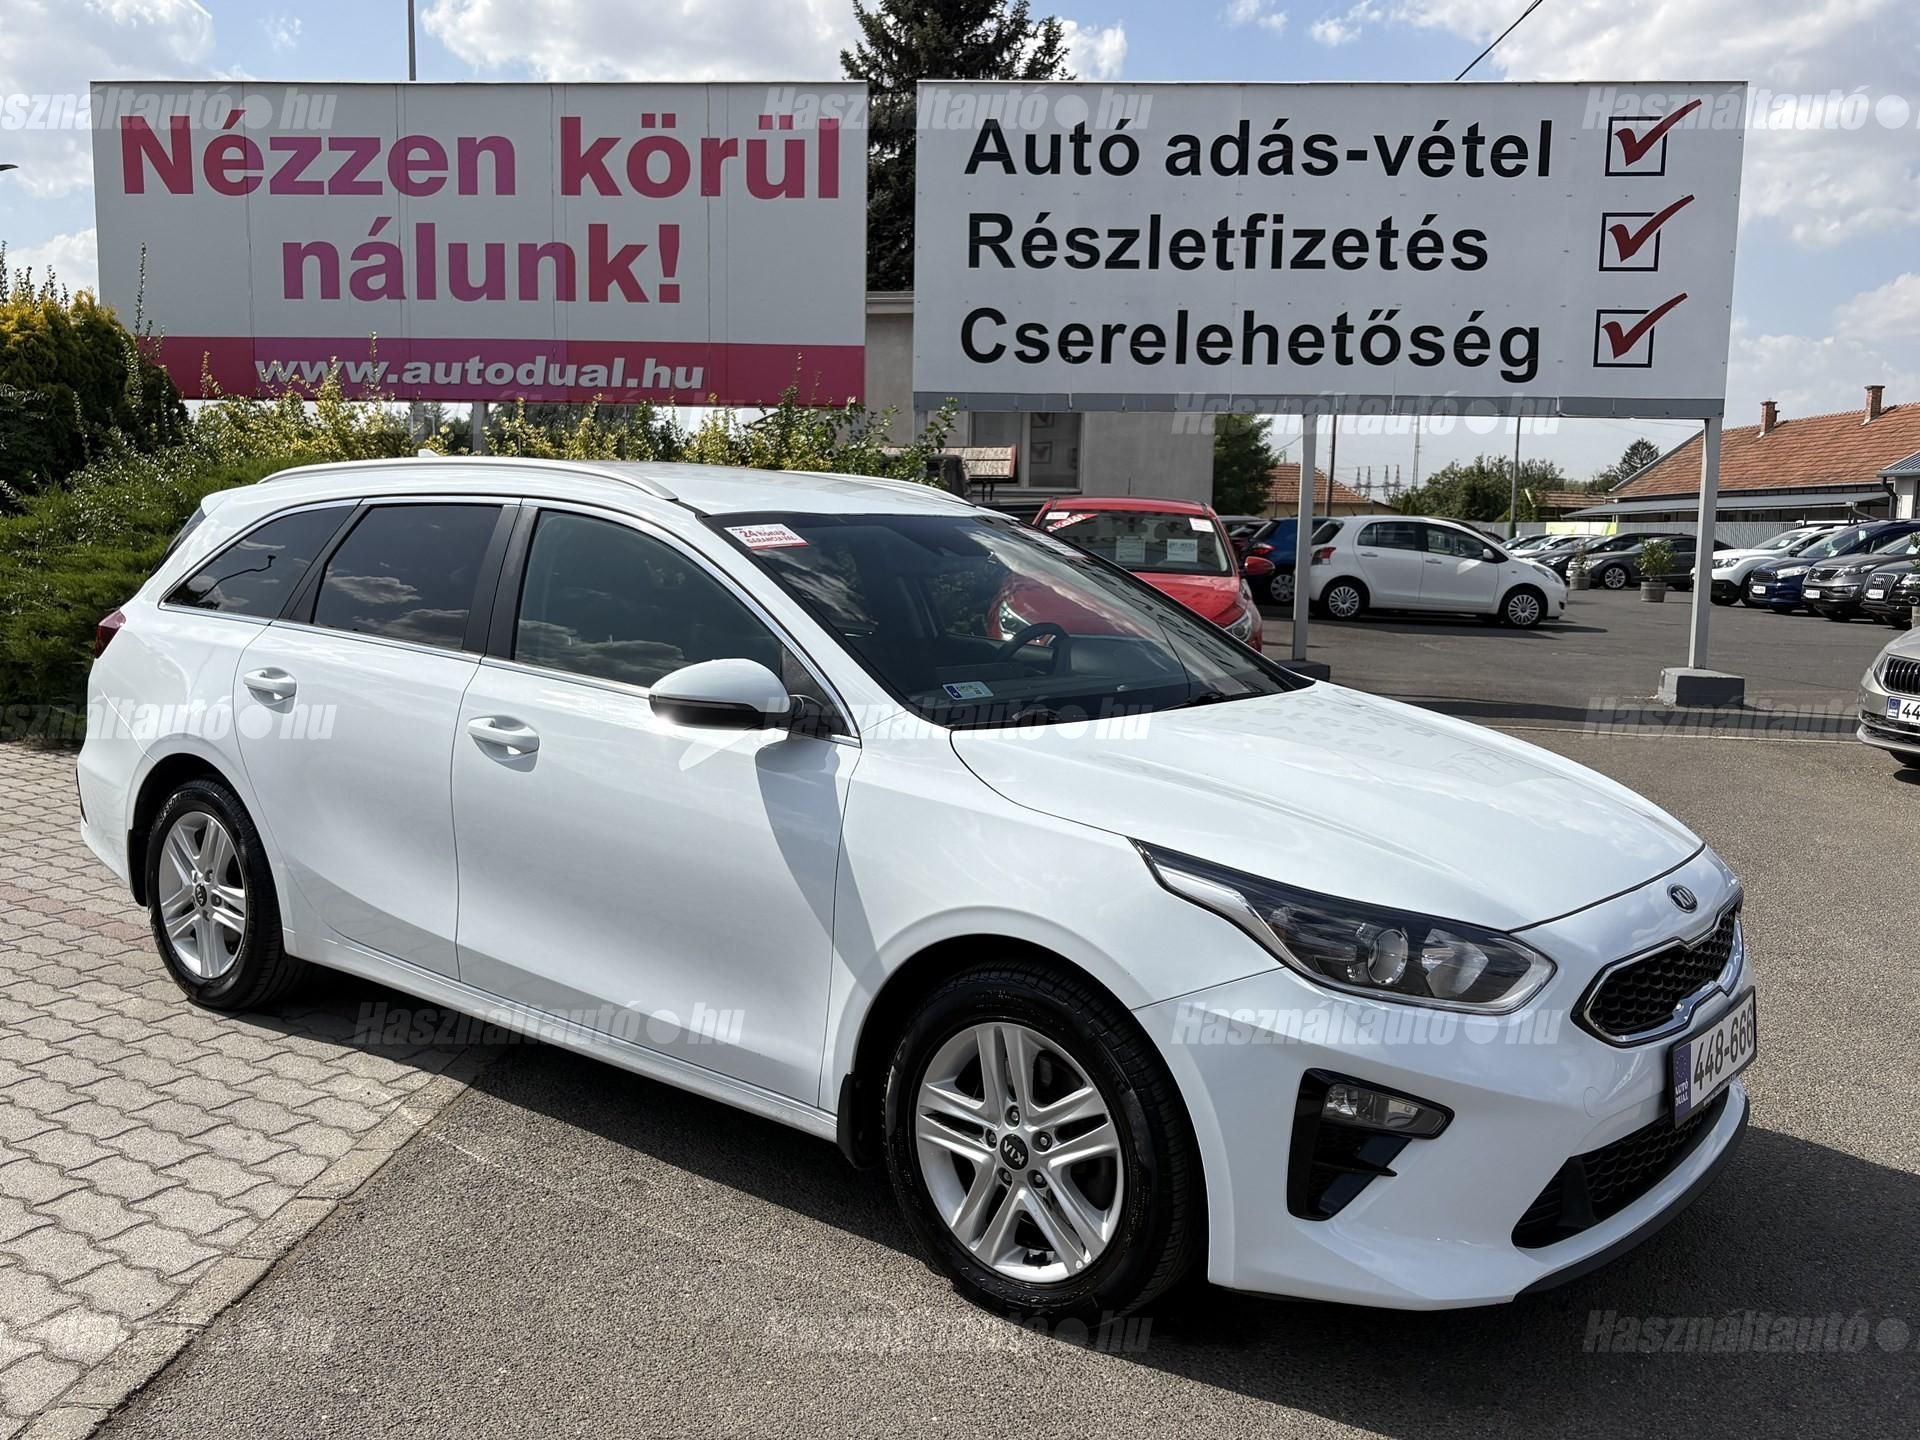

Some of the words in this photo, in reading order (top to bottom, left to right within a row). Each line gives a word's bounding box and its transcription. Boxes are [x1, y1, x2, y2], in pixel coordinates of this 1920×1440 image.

[121, 109, 515, 197] Nézzen
[561, 114, 839, 199] körül
[964, 118, 1140, 177] Autó
[1164, 118, 1554, 179] adás-vétel
[282, 217, 681, 304] nálunk!
[966, 211, 1489, 272] Részletfizetés
[254, 354, 705, 390] www.autodual.hu
[959, 307, 1541, 383] Cserelehetőség
[1693, 1003, 1753, 1091] 448-666
[1003, 1140, 1025, 1165] KIA
